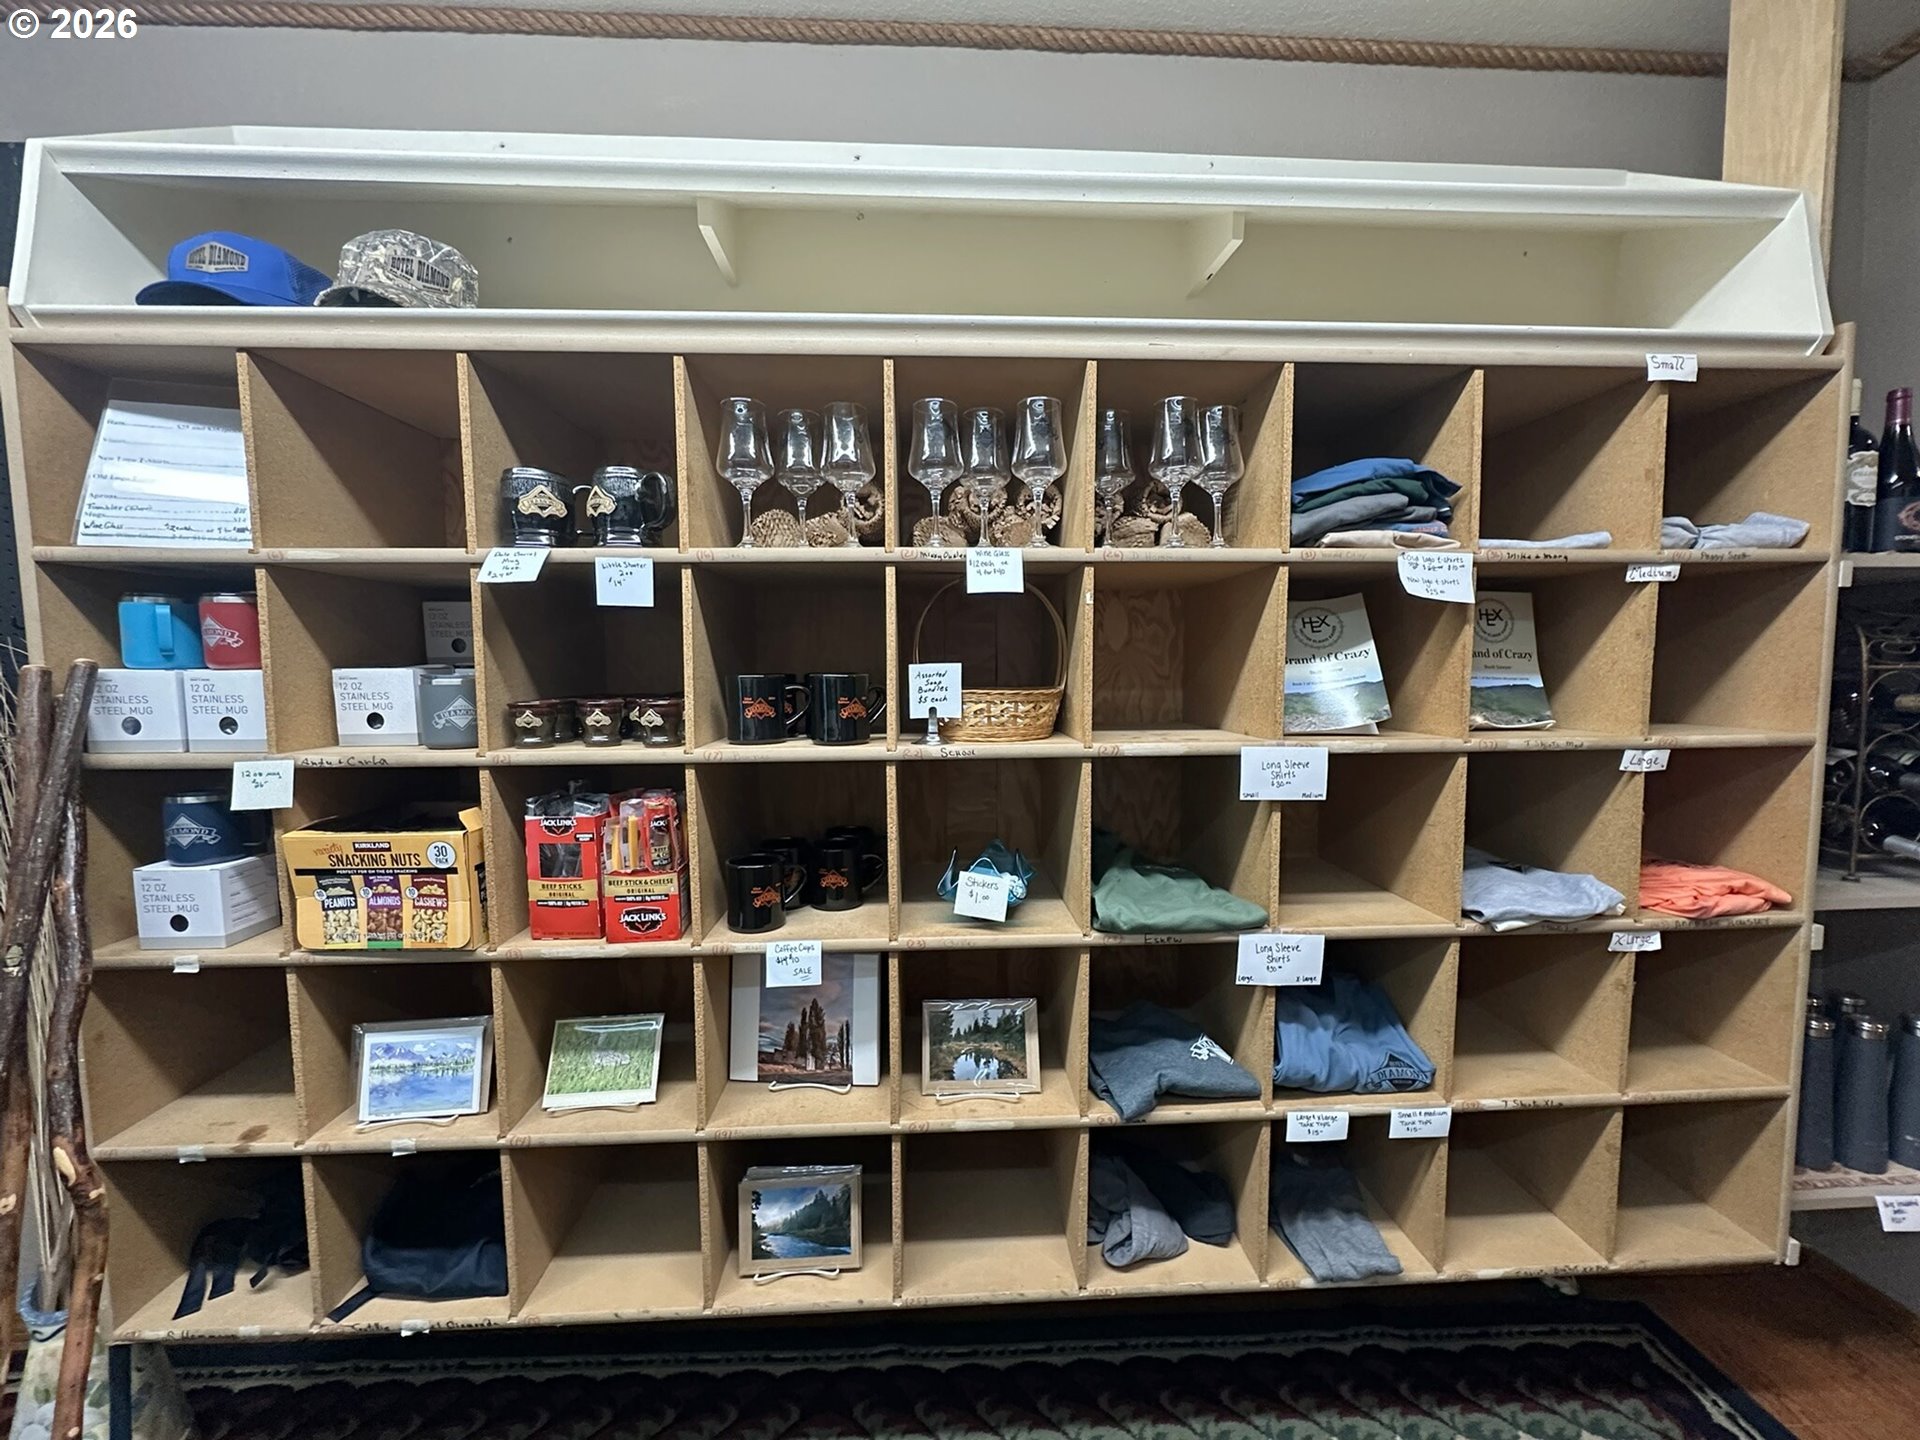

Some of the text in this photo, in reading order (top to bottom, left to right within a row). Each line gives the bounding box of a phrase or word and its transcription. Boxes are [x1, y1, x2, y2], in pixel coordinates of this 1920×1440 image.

[208, 244, 246, 266] DIAMOND
[390, 256, 414, 278] HOTEL
[416, 260, 451, 289] DIAMOND
[1650, 355, 1685, 370] Small
[602, 561, 622, 569] Little
[1320, 652, 1333, 662] of
[1334, 648, 1371, 662] Crazy
[1472, 648, 1533, 662] and of Crazy
[914, 670, 948, 679] Assorted
[105, 685, 119, 693] OZ
[190, 684, 215, 693] 12 OZ
[338, 682, 362, 690] 12 OZ
[918, 685, 948, 693] Bundles
[93, 695, 149, 704] STAINLESS
[191, 695, 244, 704] STAINLESS
[340, 692, 389, 700] STAINLESS
[94, 706, 153, 715] STEEL MUG
[192, 705, 248, 714] STEEL MUG
[341, 702, 394, 711] STEEL MUG
[440, 709, 476, 720] DIAMON
[1629, 754, 1660, 767] Large
[1261, 760, 1310, 773] Long Sleeve
[241, 770, 251, 778] 12
[1270, 770, 1296, 780] Shirts
[541, 819, 557, 827] JACK
[433, 845, 448, 857] 30
[328, 853, 421, 867] SNACKING NUTS
[141, 884, 167, 892] 12 OZ
[964, 876, 1000, 891] Stickers
[142, 894, 195, 903] STAINLESS
[324, 896, 356, 909] PEANUTS
[368, 896, 401, 906] ALMONDS
[414, 897, 447, 908] CASHEWS
[143, 904, 199, 913] STEEL MUG
[619, 911, 667, 923] JACK LINK'S
[774, 943, 816, 954] Coffee Cups
[1255, 942, 1301, 956] Long Sleeve
[1266, 954, 1290, 964] Shirts
[793, 966, 813, 976] SALE
